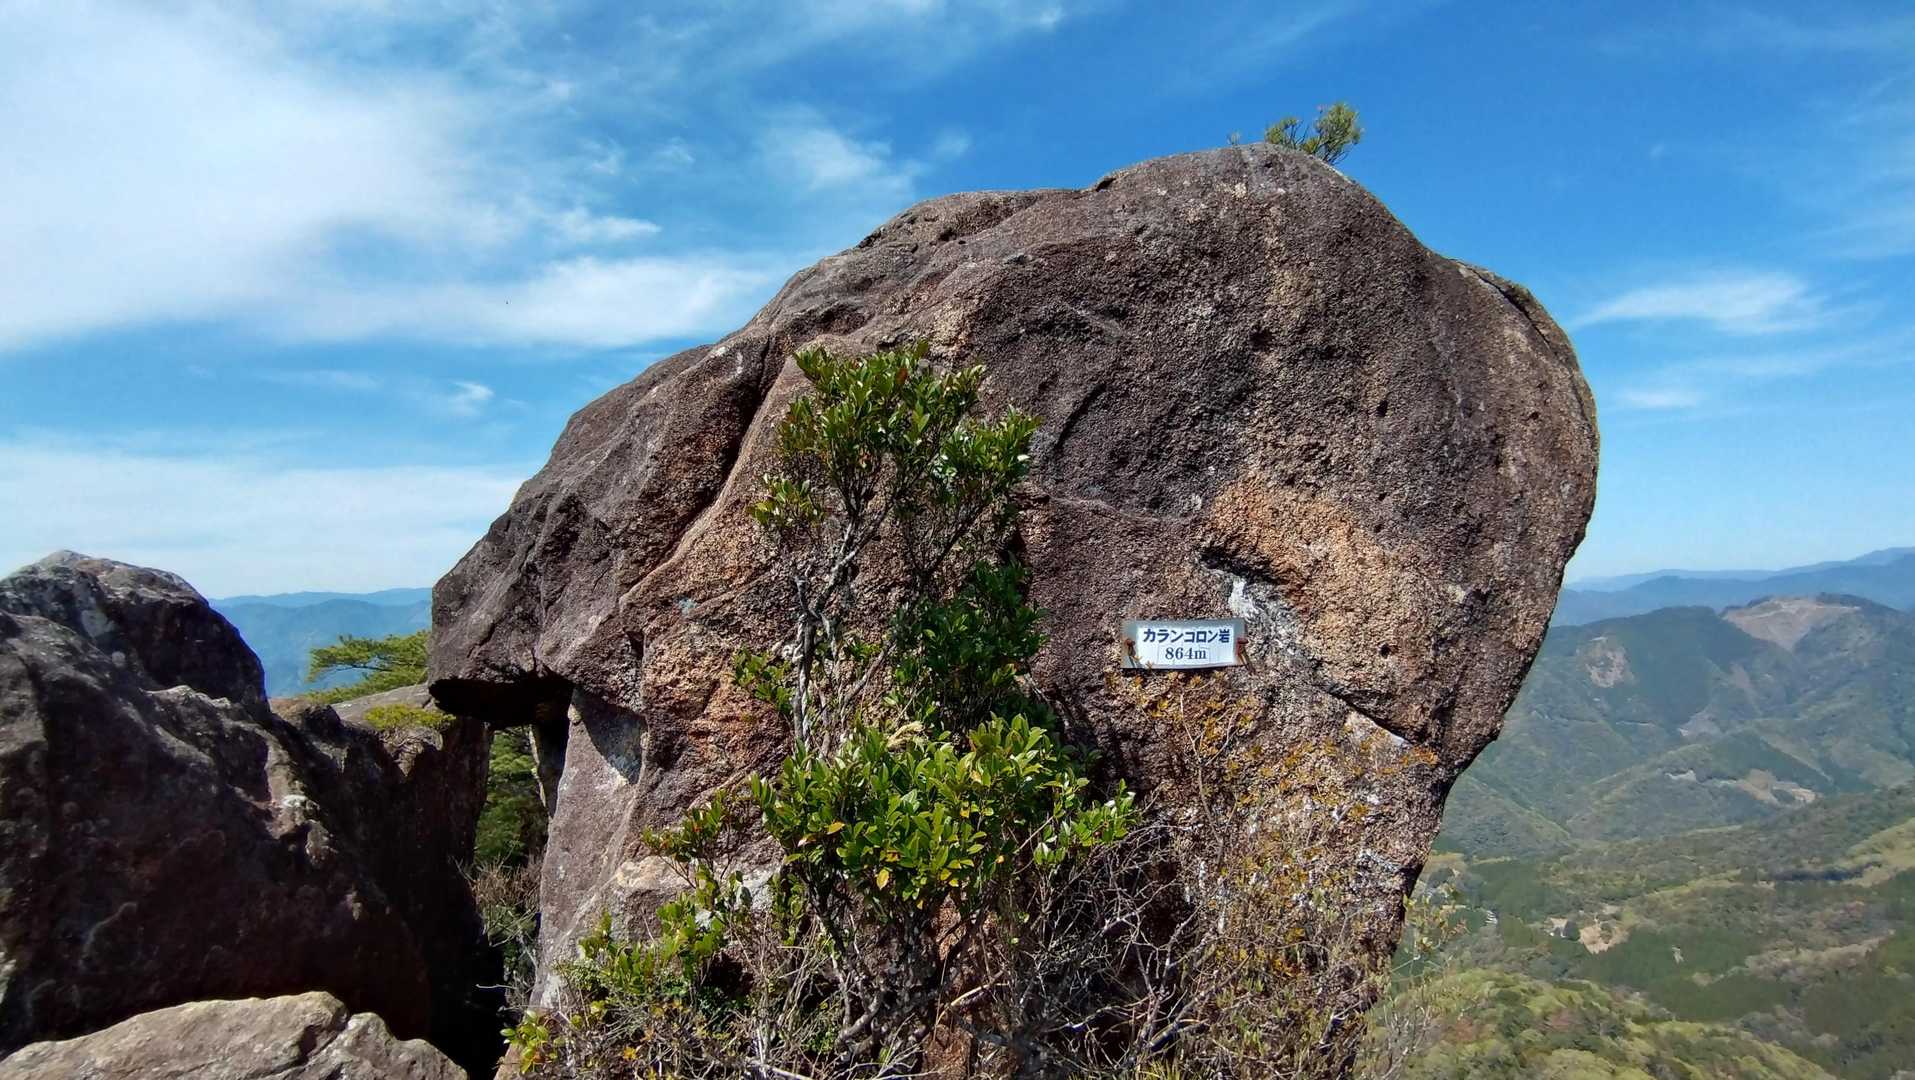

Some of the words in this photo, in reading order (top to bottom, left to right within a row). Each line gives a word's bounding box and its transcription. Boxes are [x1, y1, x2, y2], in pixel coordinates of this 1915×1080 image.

[1143, 628, 1230, 643] カランコロン岩
[1165, 647, 1207, 660] 864m
